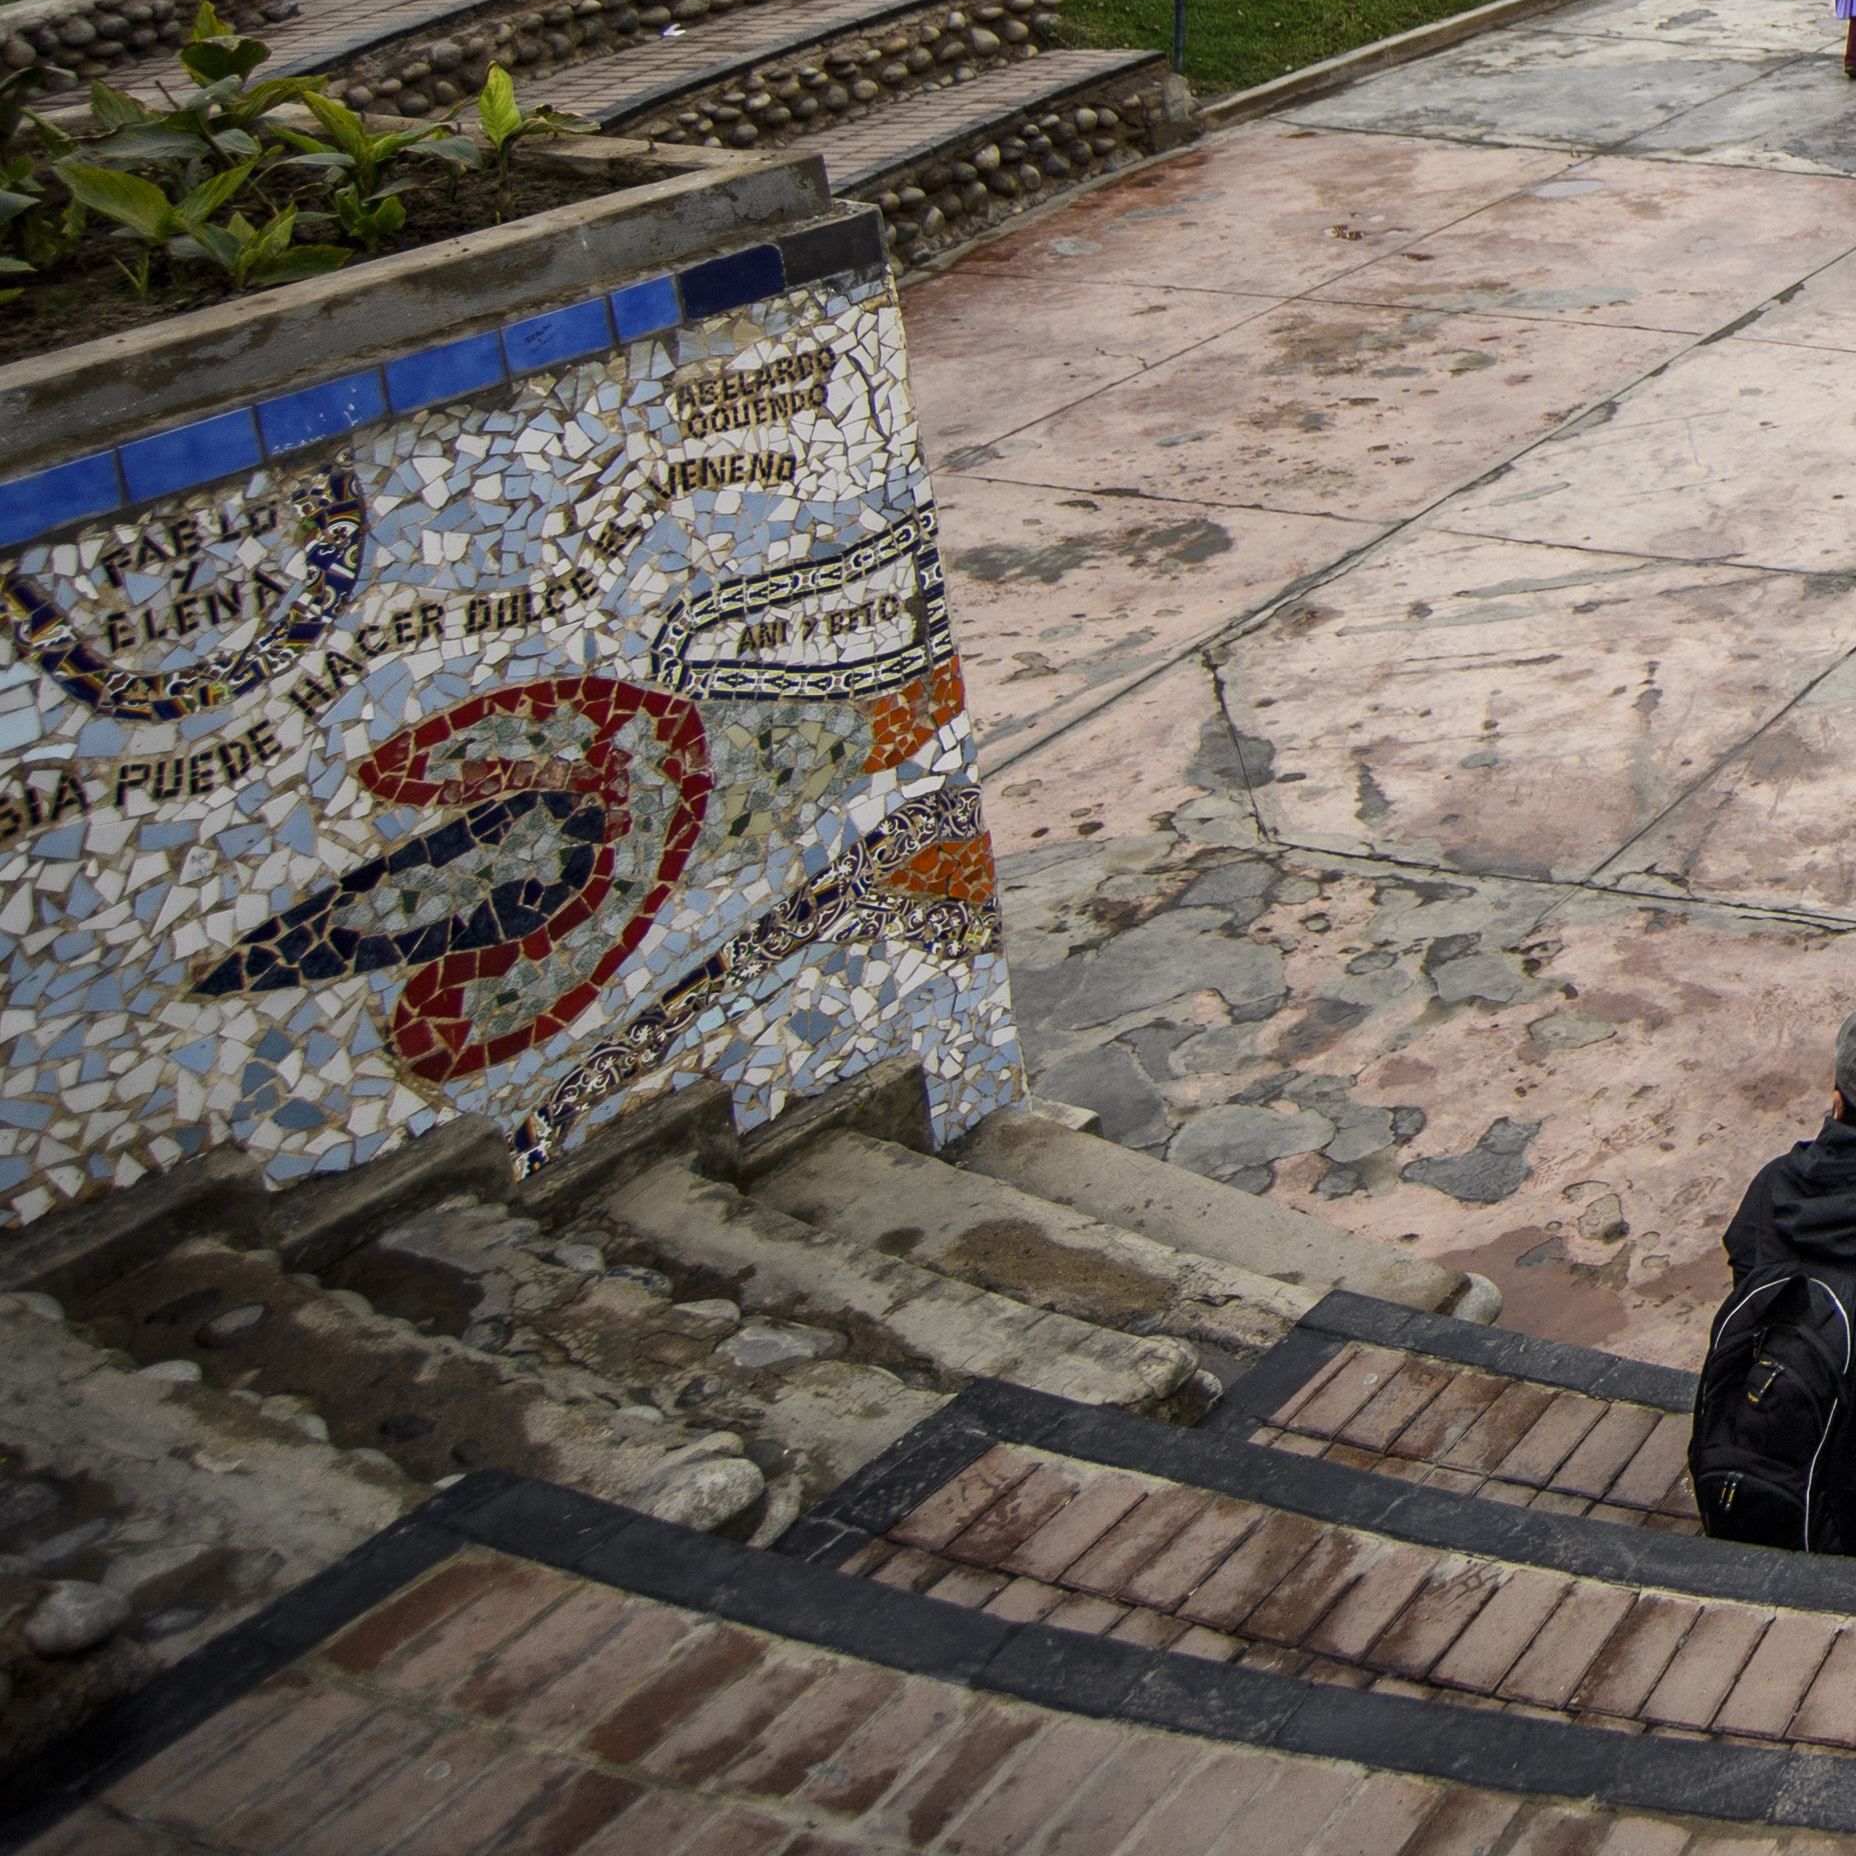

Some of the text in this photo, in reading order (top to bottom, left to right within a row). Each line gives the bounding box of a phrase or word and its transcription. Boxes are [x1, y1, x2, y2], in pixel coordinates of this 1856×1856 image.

[675, 345, 838, 412] ABELARDO
[686, 382, 830, 440] OQUENDO
[101, 499, 280, 588] PABLO
[106, 567, 288, 653] ELENA
[114, 719, 285, 806] PUEDE
[290, 603, 445, 717] HACER
[466, 567, 600, 634] DULCE
[646, 453, 797, 500] VENENO
[737, 595, 900, 653] ANI Y BETO
